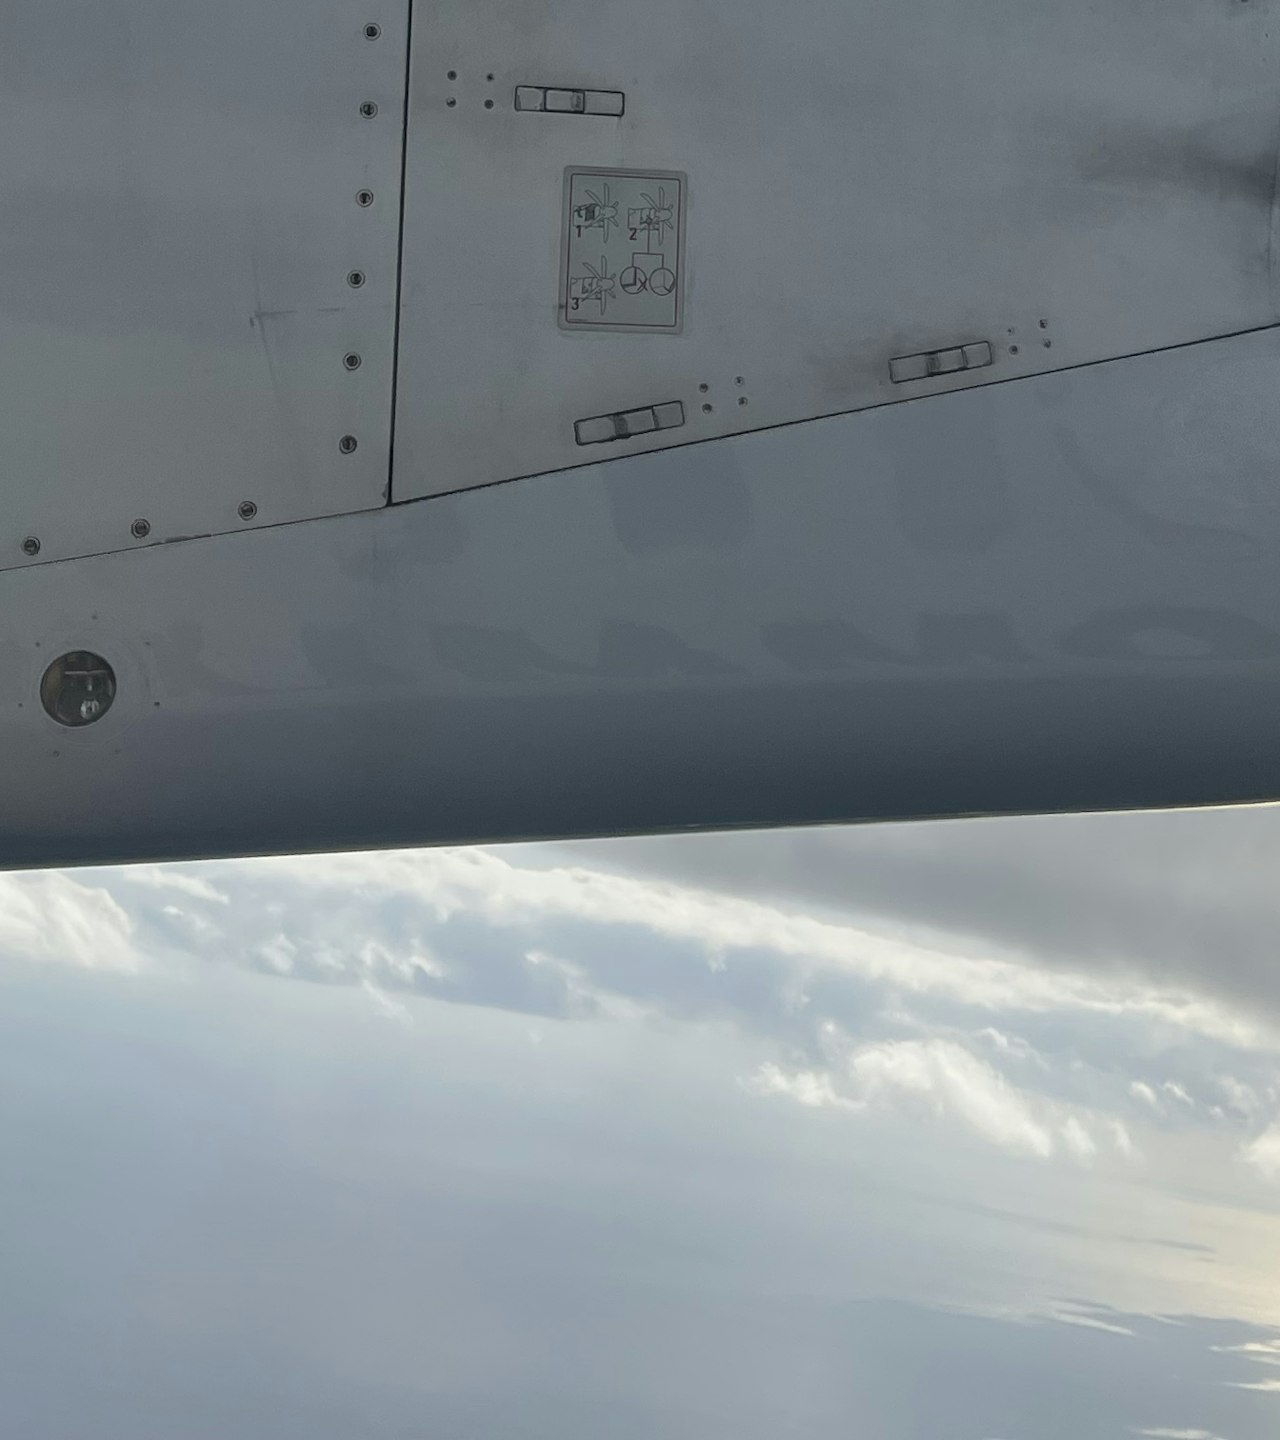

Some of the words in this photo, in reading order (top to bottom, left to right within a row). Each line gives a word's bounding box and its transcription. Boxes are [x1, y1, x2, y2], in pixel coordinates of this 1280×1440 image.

[576, 225, 582, 238] 1
[629, 228, 637, 241] 2
[571, 297, 580, 311] 3
